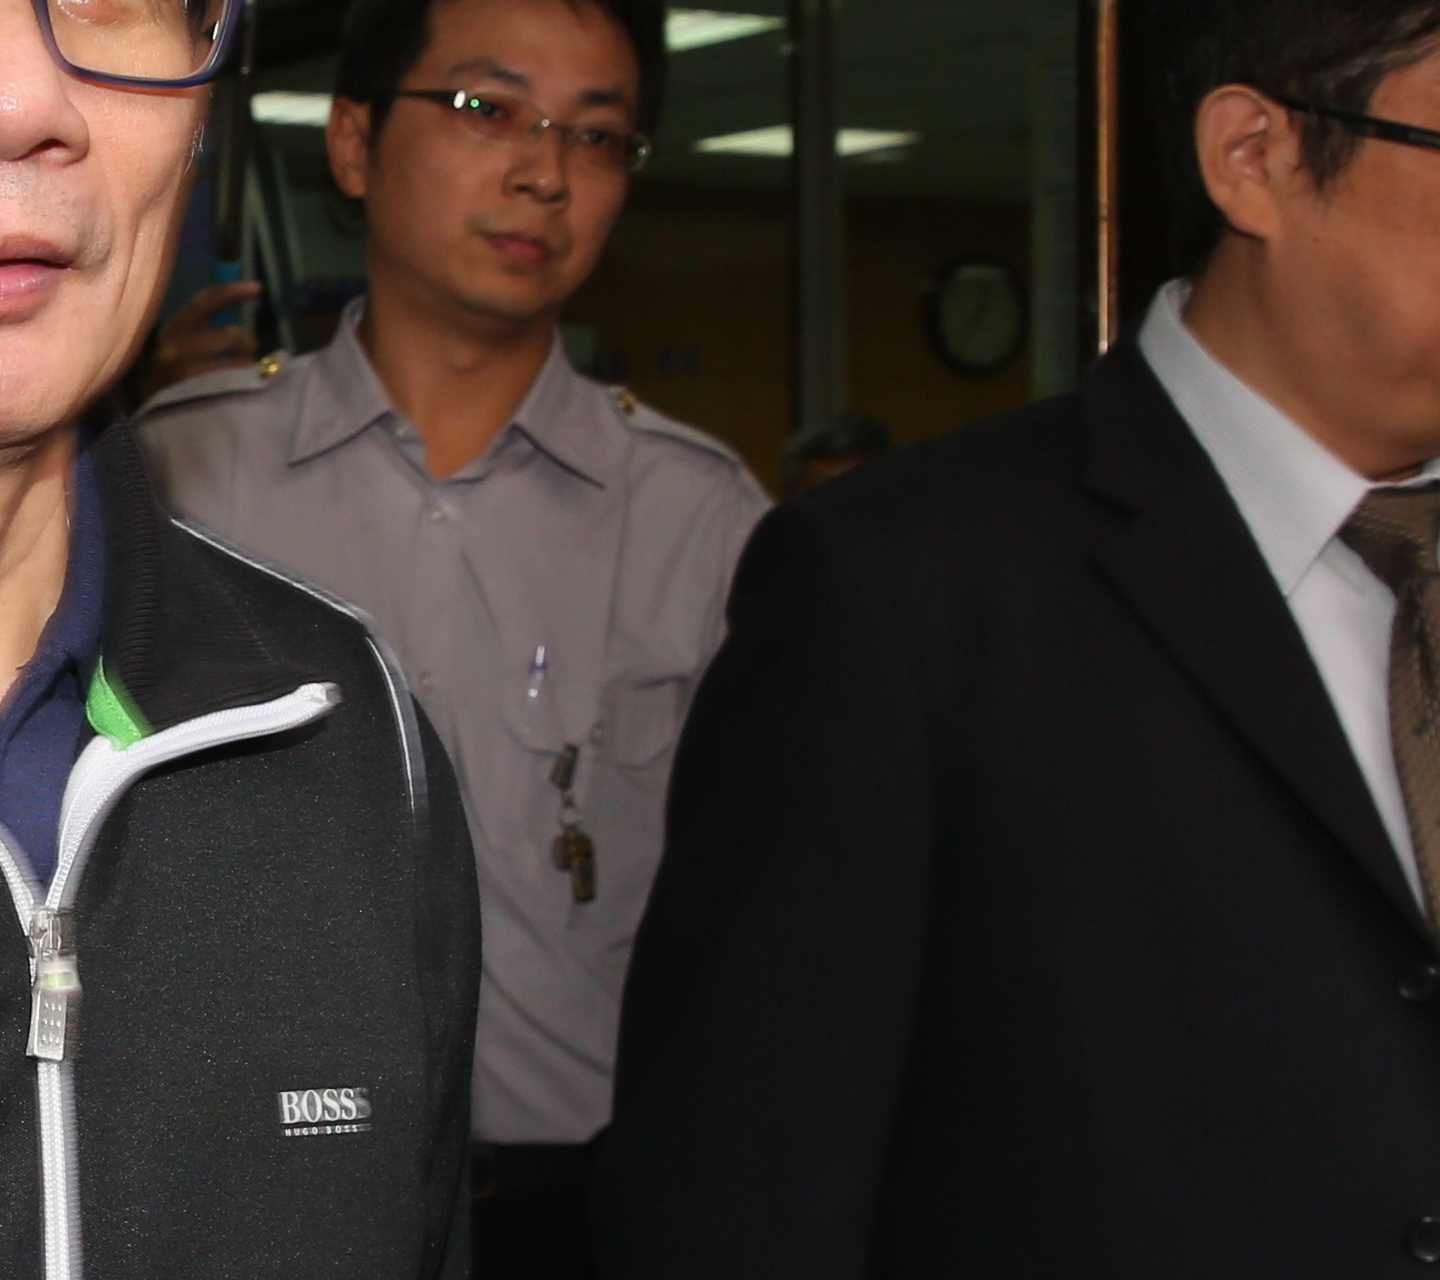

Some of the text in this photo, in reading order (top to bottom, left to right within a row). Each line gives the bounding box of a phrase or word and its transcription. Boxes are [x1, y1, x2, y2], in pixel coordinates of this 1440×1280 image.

[279, 1087, 359, 1124] BOSS
[284, 1124, 359, 1137] HUGO BOSS
